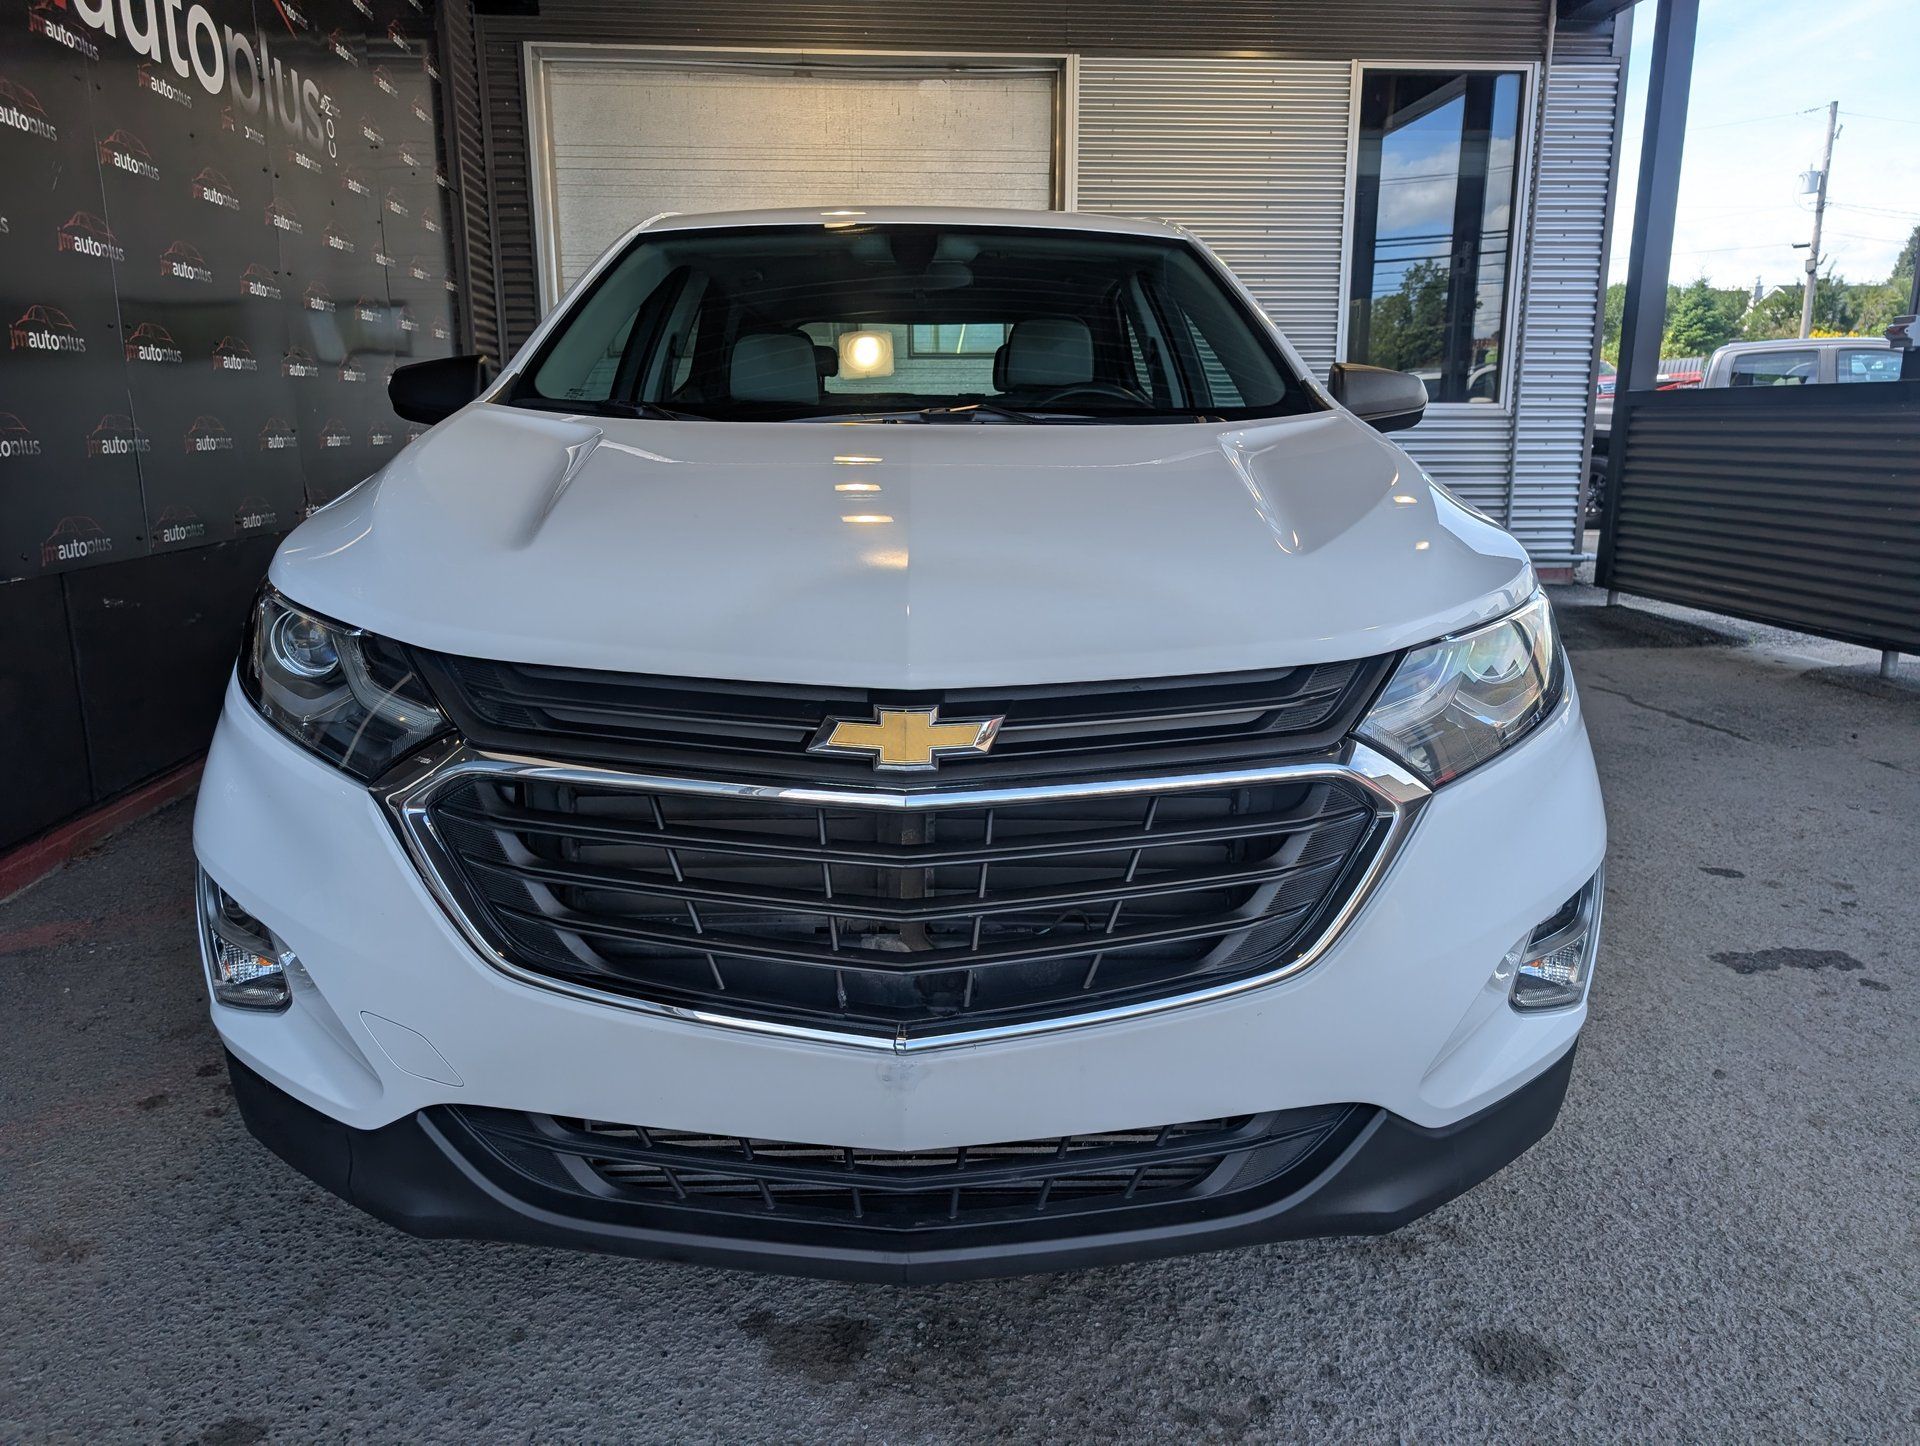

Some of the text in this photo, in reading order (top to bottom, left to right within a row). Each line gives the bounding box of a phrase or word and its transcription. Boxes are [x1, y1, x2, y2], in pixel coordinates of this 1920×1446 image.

[0, 106, 57, 141] autoplus
[9, 324, 86, 352] jmautoplus
[125, 340, 182, 363] jmautoplus
[40, 537, 112, 567] jmautoplus
